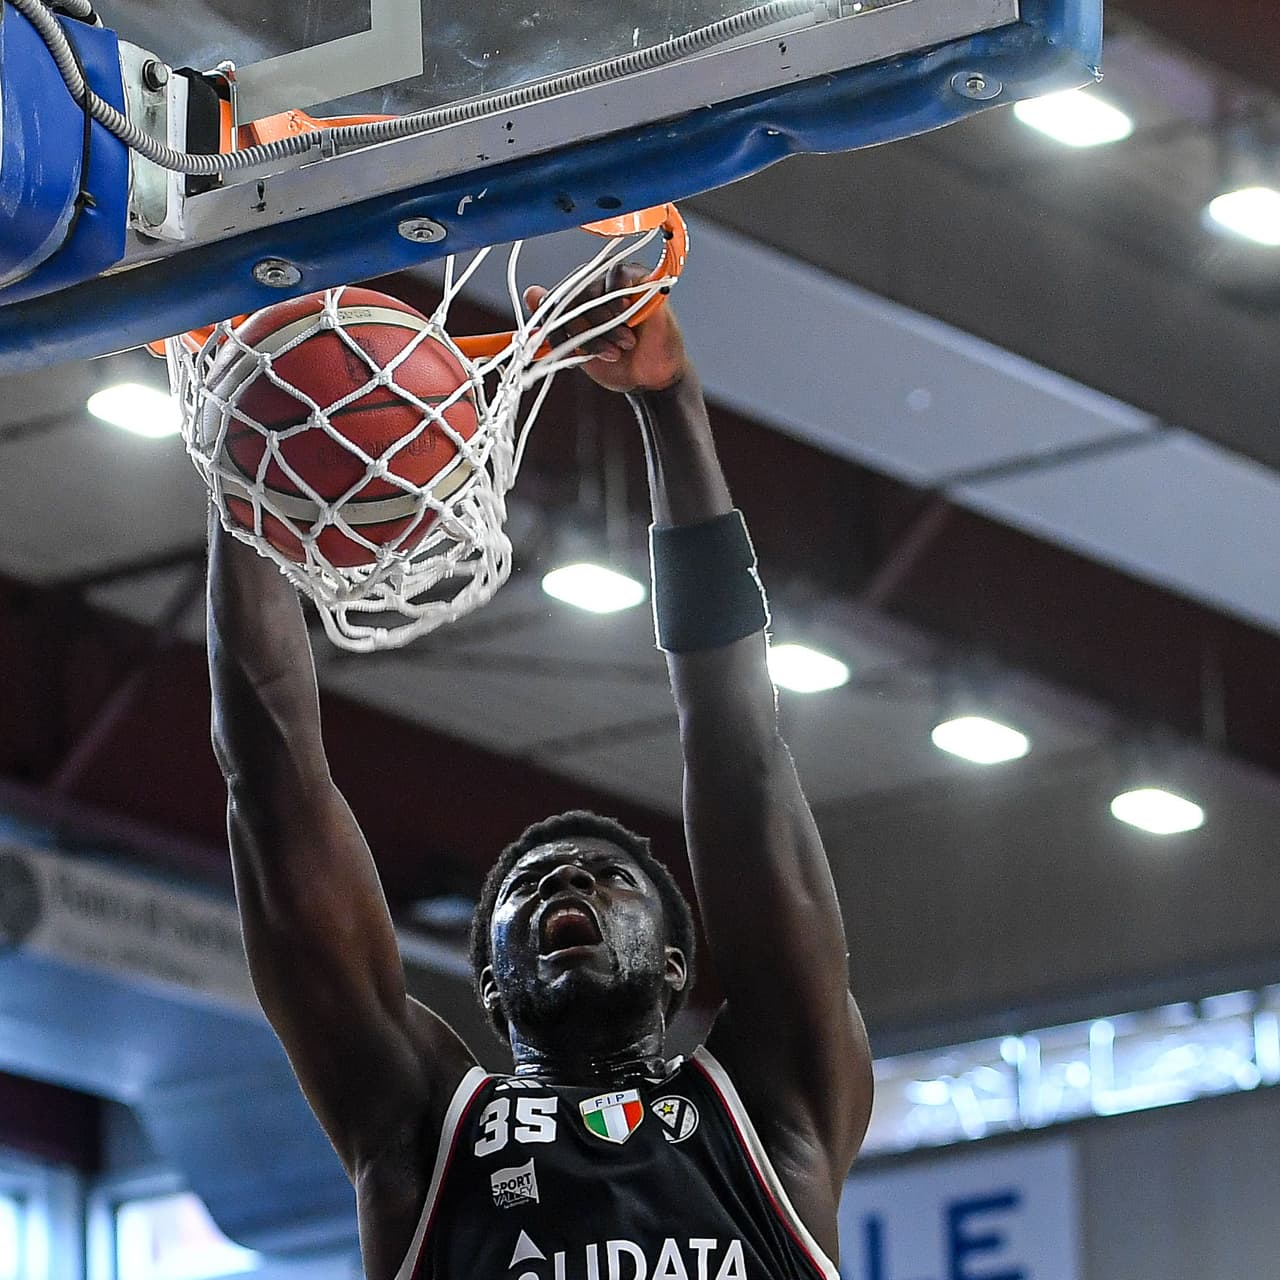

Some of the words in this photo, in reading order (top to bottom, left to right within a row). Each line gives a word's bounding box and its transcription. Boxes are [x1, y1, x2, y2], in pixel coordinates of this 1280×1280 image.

[595, 1093, 625, 1108] FIP
[474, 1096, 558, 1157] 35
[492, 1172, 532, 1196] SPORT
[493, 1186, 533, 1207] VALLEY
